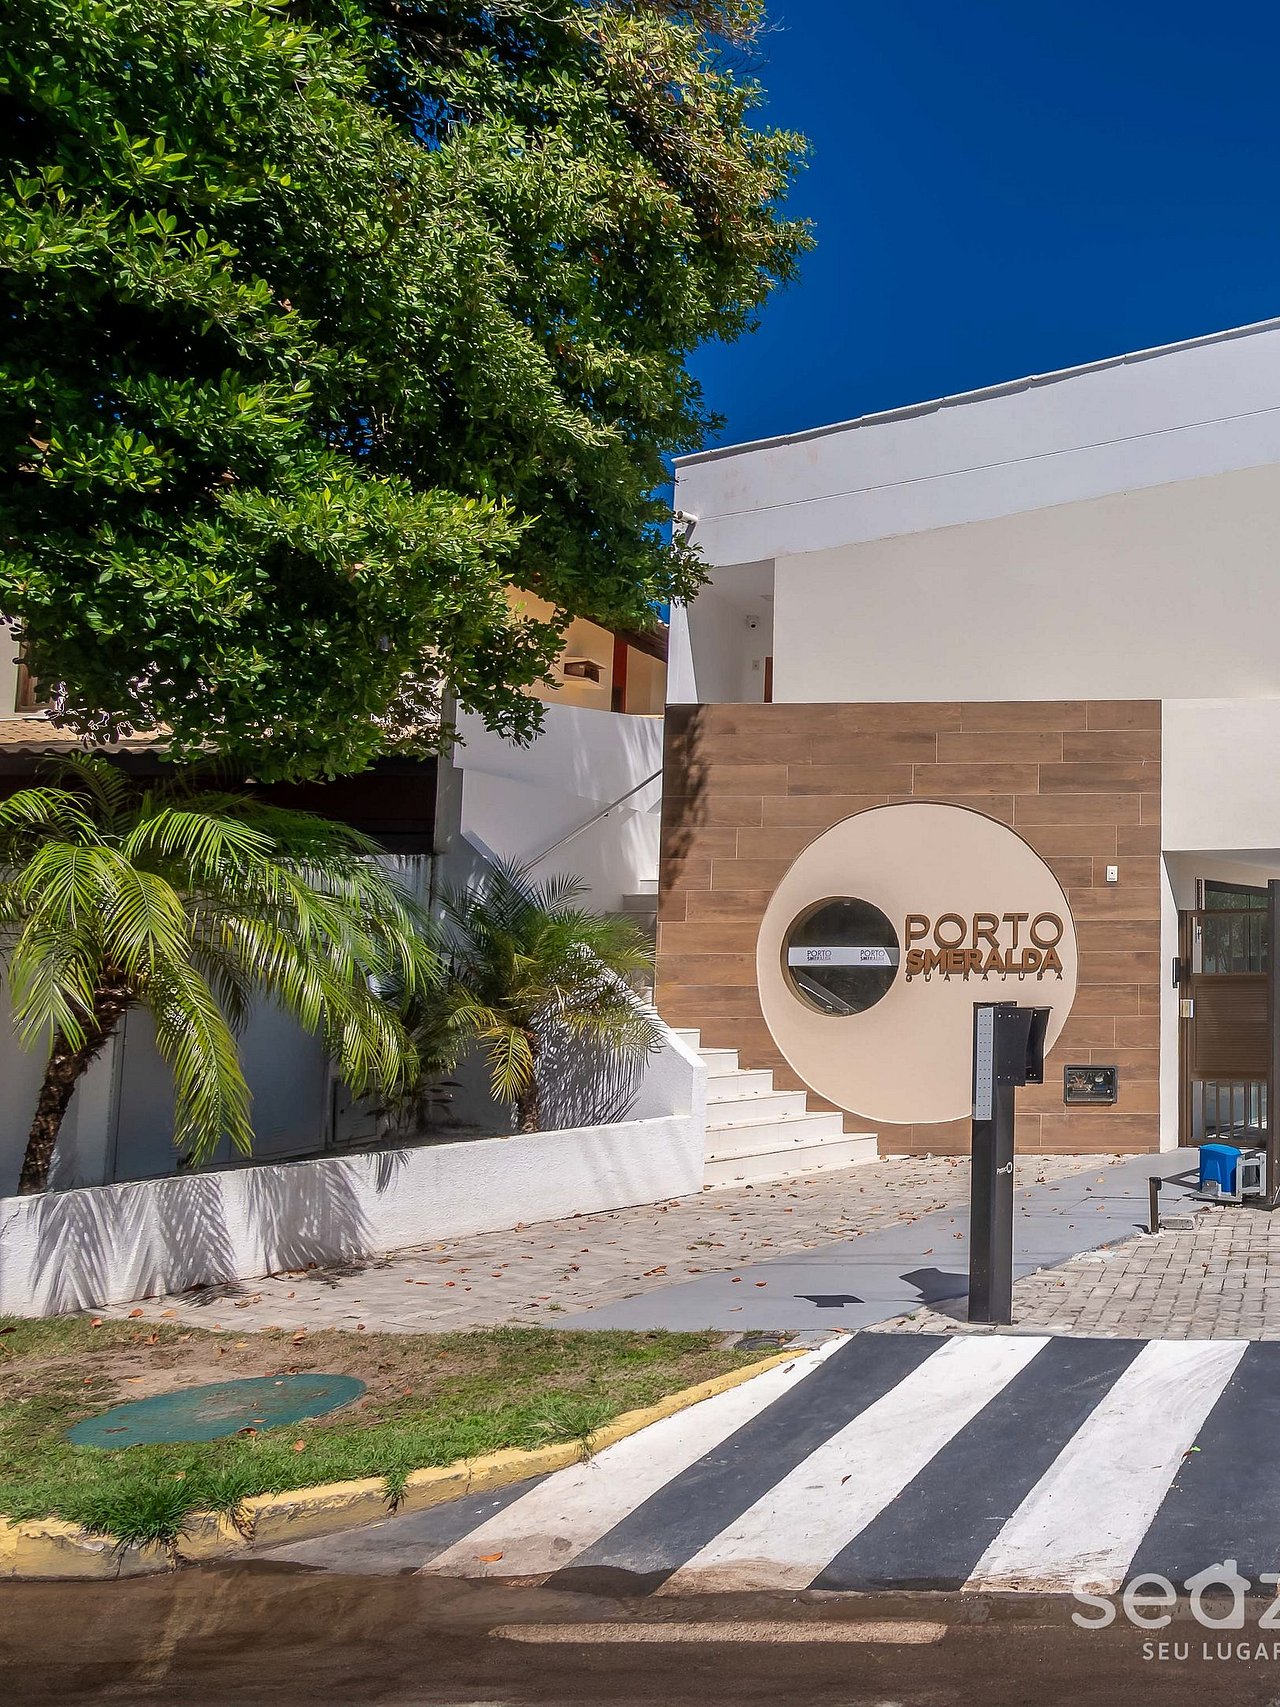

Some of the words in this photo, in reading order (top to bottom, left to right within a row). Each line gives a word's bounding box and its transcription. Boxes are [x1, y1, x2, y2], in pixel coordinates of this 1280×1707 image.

[905, 912, 1064, 950] PORTO
[807, 949, 832, 957] PORTO
[860, 949, 885, 957] PORTO
[905, 948, 1063, 975] SMERALDA
